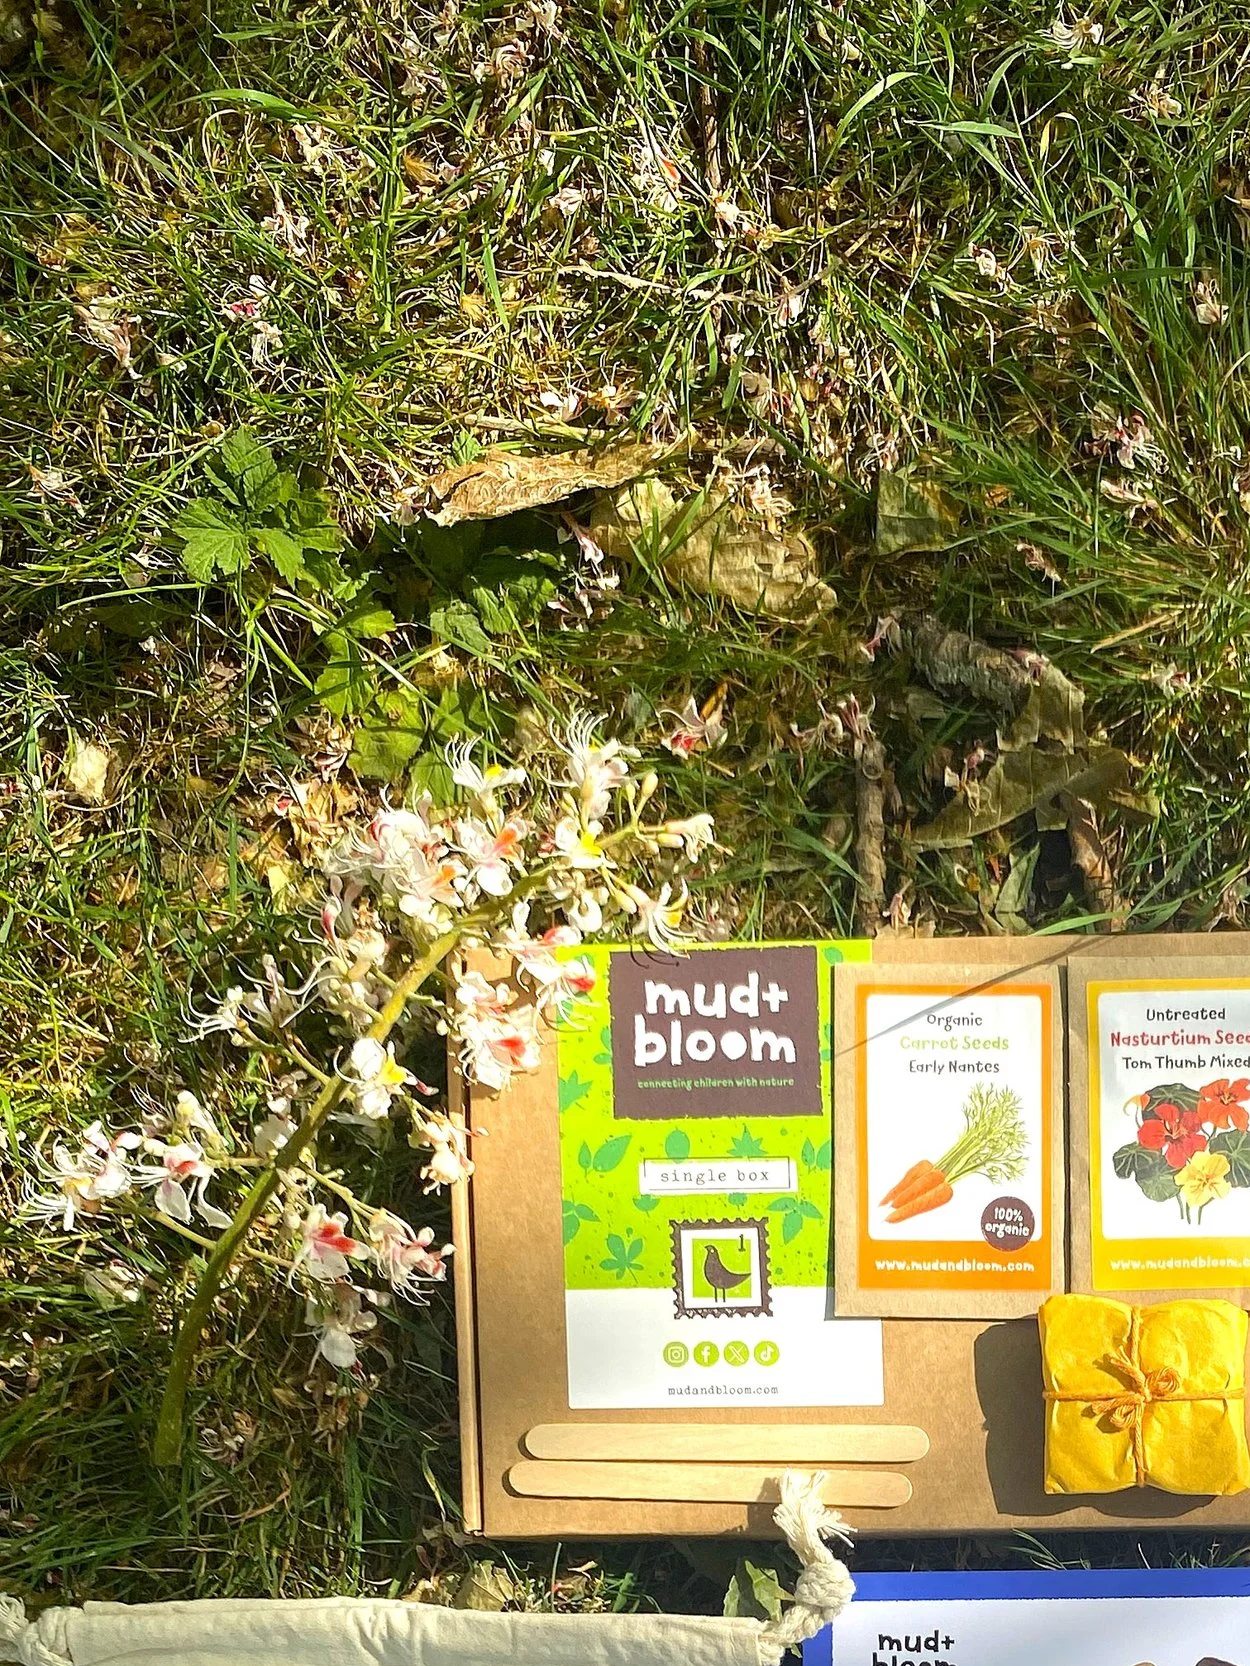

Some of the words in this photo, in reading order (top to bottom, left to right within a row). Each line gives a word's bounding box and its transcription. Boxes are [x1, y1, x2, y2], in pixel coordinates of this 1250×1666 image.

[645, 970, 788, 1018] mud+
[927, 1012, 982, 1031] Organic
[1146, 1008, 1225, 1021] Untreated
[634, 1014, 796, 1067] bloom
[900, 1036, 958, 1049] Carrot
[962, 1036, 1009, 1049] Seeds
[1111, 1029, 1211, 1046] Nasturtium
[909, 1060, 944, 1074] Early
[948, 1061, 1000, 1072] Nantes
[1122, 1057, 1151, 1069] Tom
[1155, 1056, 1206, 1069] Thumb
[1210, 1054, 1250, 1068] Mixed
[638, 1078, 692, 1091] connecting
[694, 1078, 734, 1087] children
[735, 1078, 757, 1087] with
[759, 1078, 794, 1086] nature
[660, 1169, 726, 1185] single
[737, 1170, 769, 1181] box
[994, 1207, 1023, 1221] 100%
[985, 1221, 1030, 1238] organic
[739, 1234, 746, 1251] 1
[875, 1259, 1034, 1272] www.mudandbloom.com
[668, 1385, 778, 1395] mudandbloom.com
[878, 1630, 954, 1653] mud+
